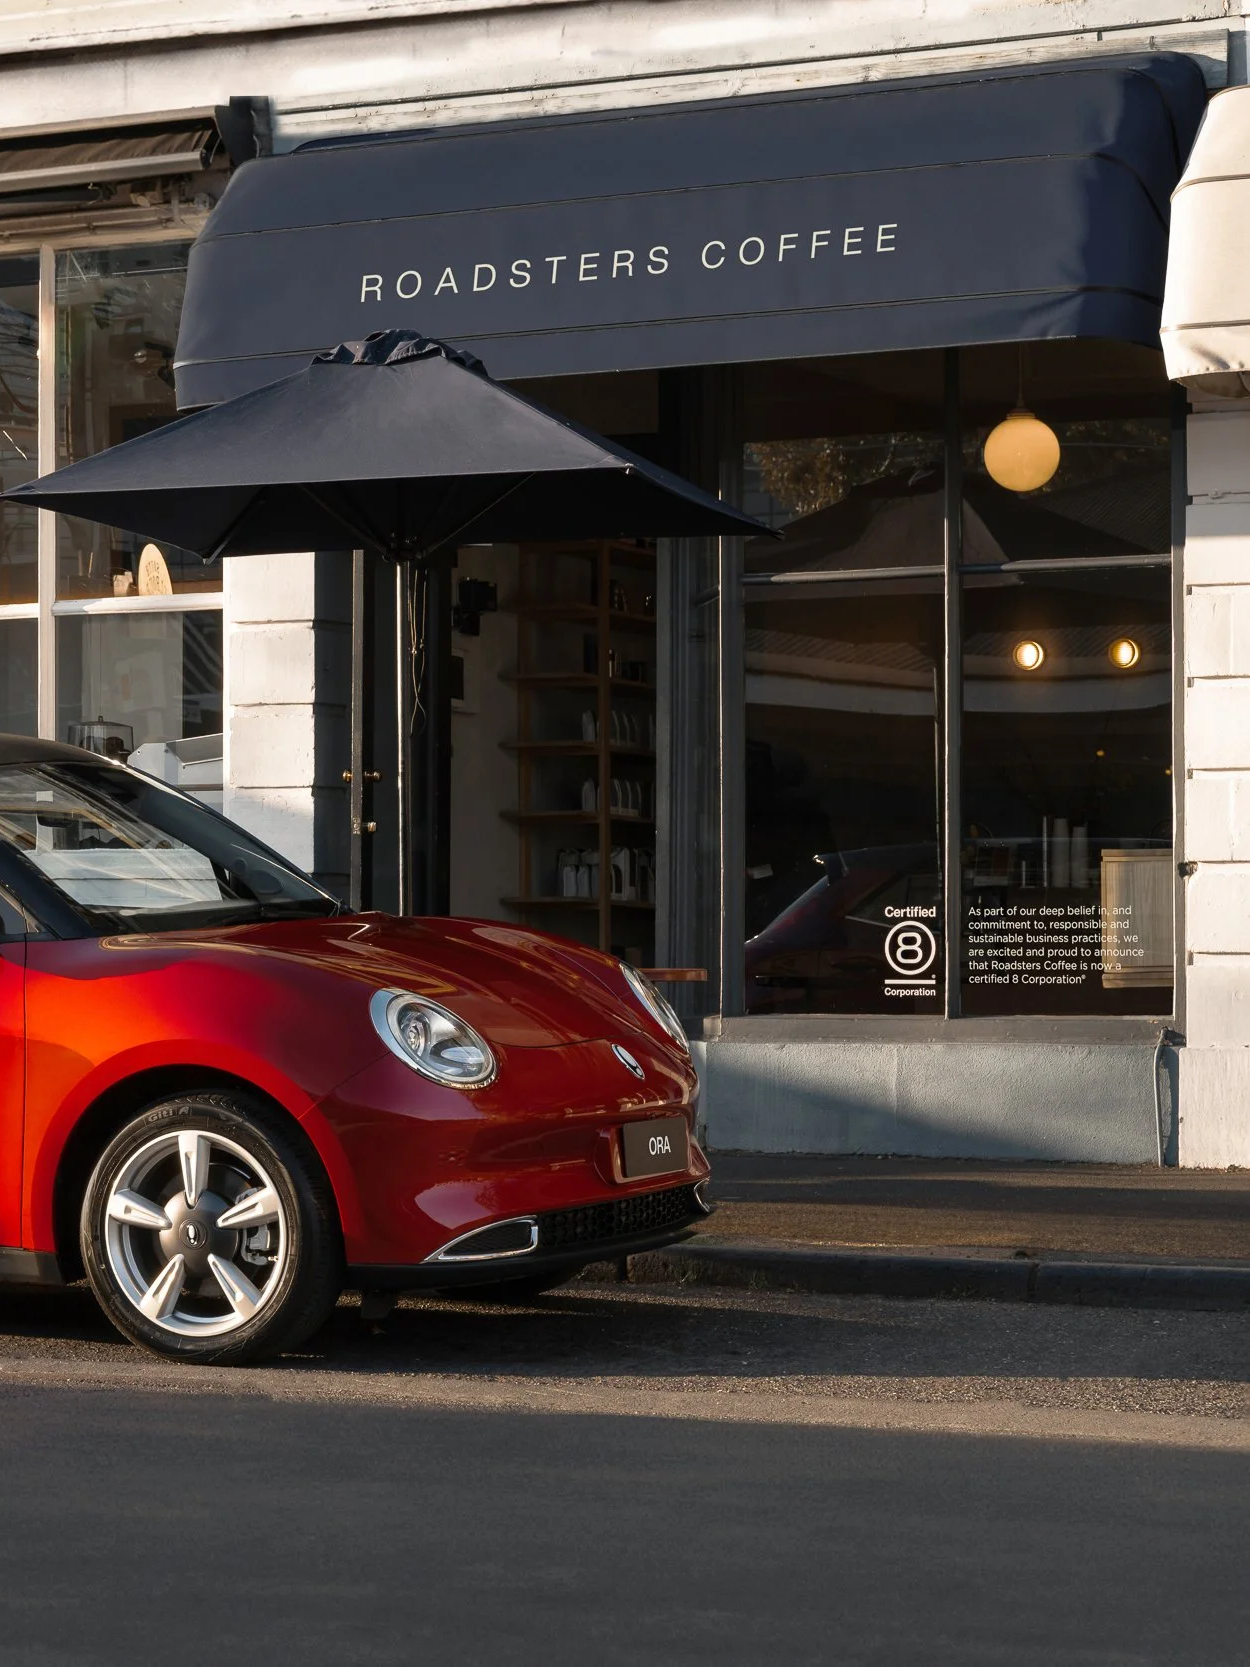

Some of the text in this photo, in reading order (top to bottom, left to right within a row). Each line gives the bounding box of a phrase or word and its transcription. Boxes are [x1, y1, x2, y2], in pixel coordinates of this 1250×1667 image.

[360, 223, 898, 303] ROADSTERS COFFEE
[884, 906, 937, 918] Certified
[969, 907, 981, 915] As
[984, 908, 1003, 917] part
[1007, 906, 1017, 915] of
[1039, 906, 1064, 916] deep
[1068, 906, 1096, 915] belief
[1099, 906, 1109, 916] in,
[1112, 906, 1131, 915] and
[969, 919, 1129, 930] commitment to, responsible and
[969, 933, 1138, 944] sustainable business practices, we
[987, 947, 1023, 956] excited
[1026, 947, 1044, 956] and
[1048, 947, 1077, 958] proud
[1080, 948, 1091, 956] to
[969, 961, 988, 970] that
[992, 961, 1041, 970] Roadsters
[1044, 961, 1077, 970] Coffee
[1080, 961, 1087, 970] is
[969, 974, 1009, 984] certified
[884, 987, 936, 998] Corporation
[148, 1109, 173, 1121] Giti
[648, 1135, 671, 1155] ORA
